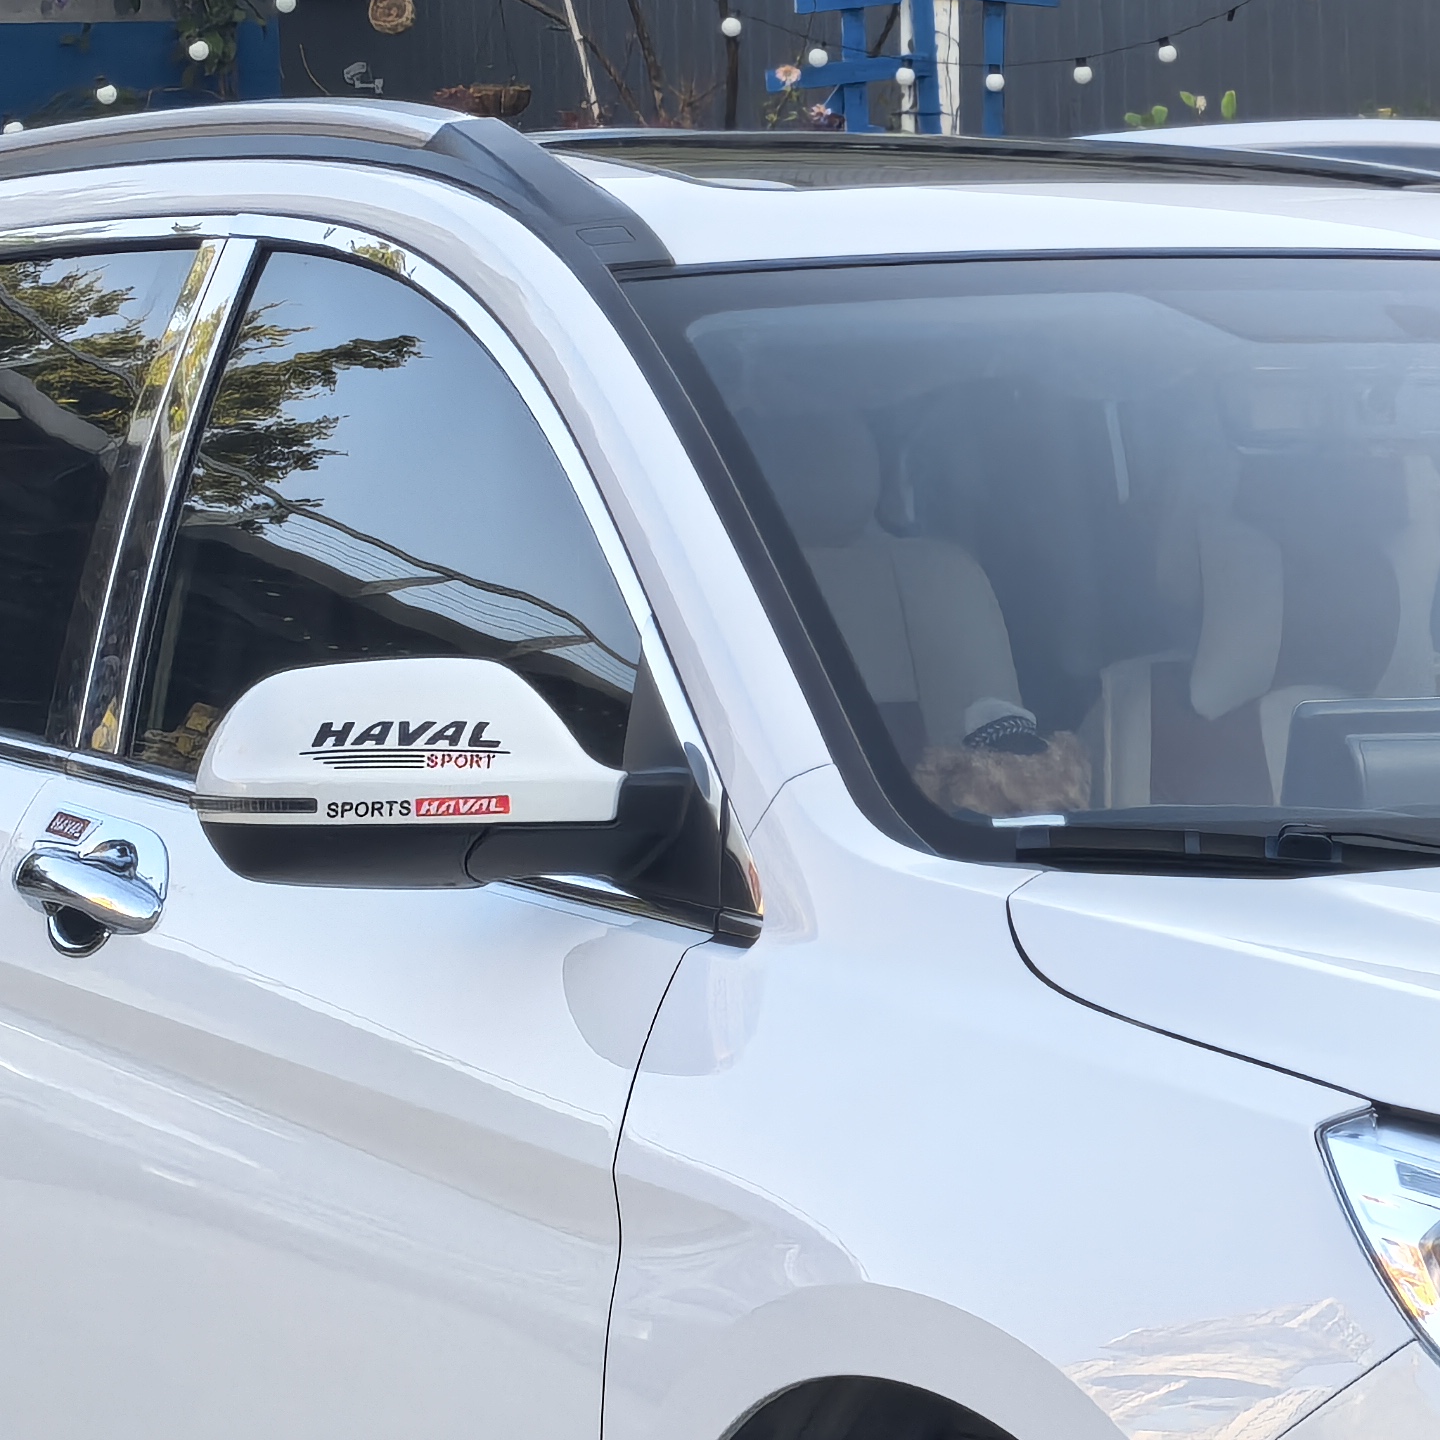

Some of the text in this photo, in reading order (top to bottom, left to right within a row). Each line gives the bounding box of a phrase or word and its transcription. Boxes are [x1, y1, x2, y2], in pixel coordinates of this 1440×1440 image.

[311, 720, 502, 748] HAVAL
[426, 753, 496, 769] SPORT
[326, 796, 505, 819] SPORTS HAVAL
